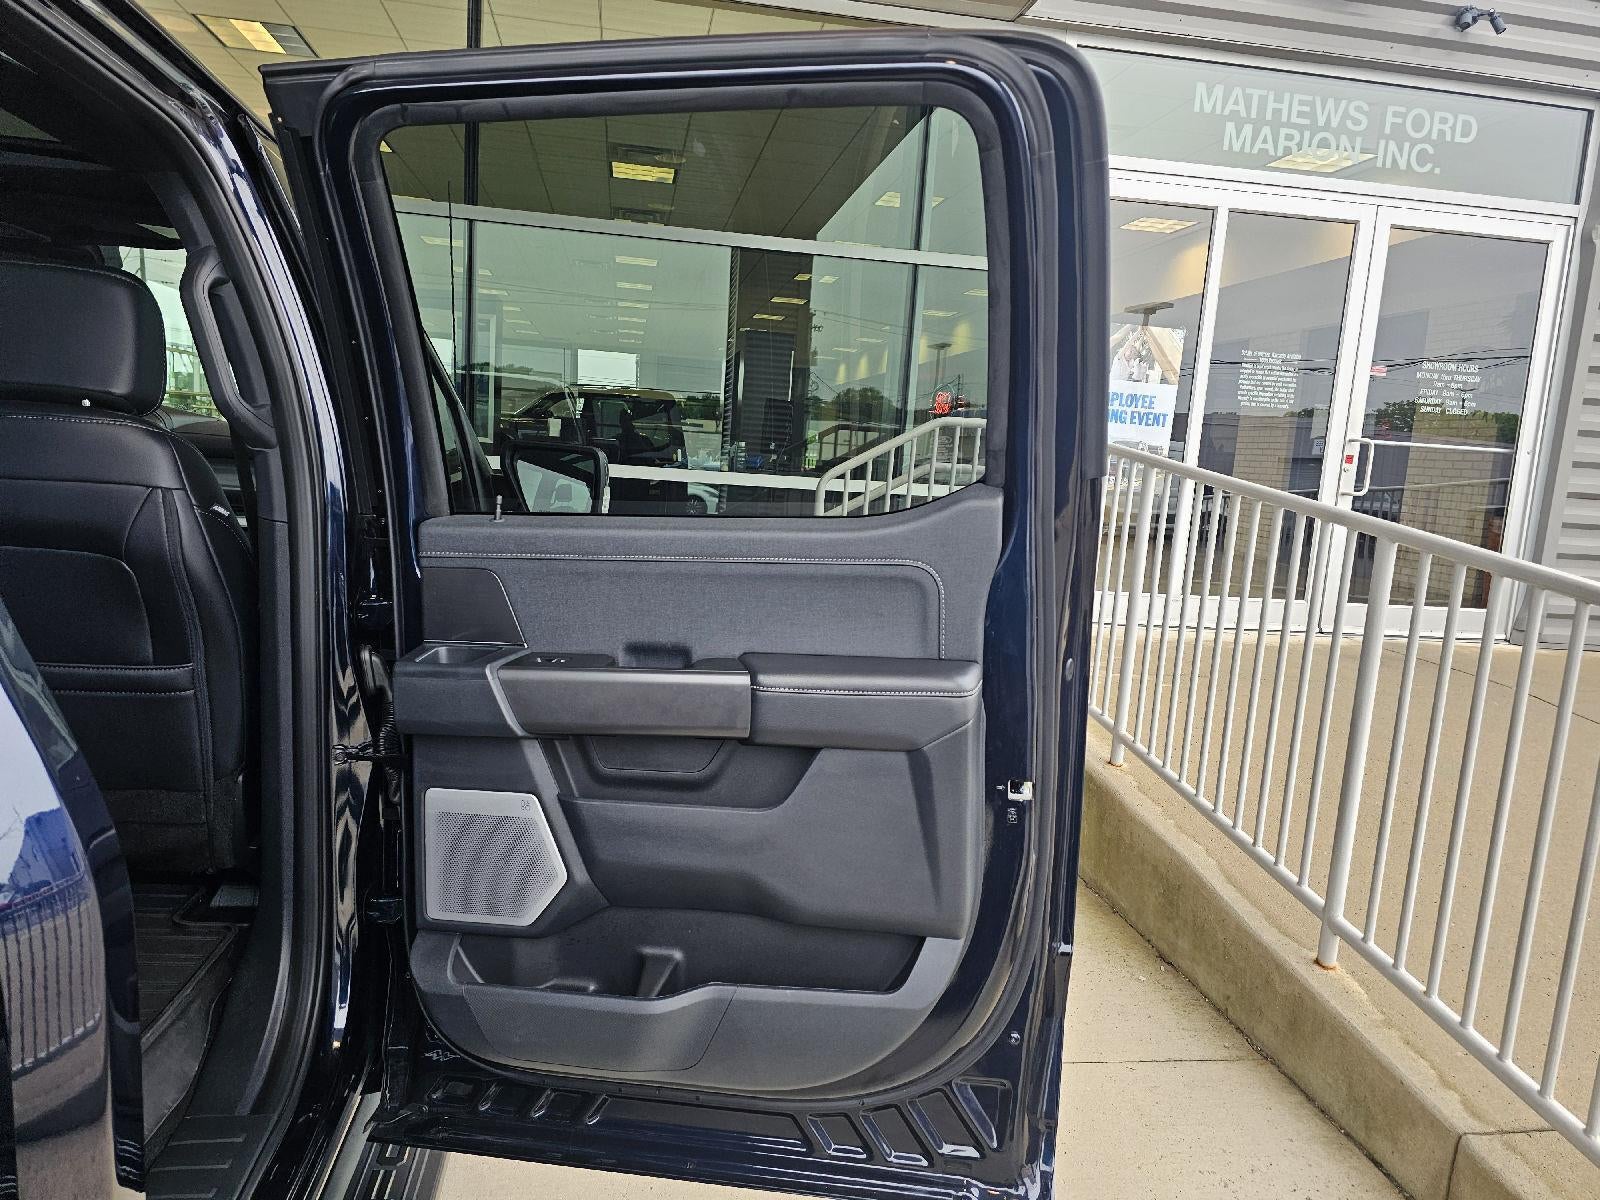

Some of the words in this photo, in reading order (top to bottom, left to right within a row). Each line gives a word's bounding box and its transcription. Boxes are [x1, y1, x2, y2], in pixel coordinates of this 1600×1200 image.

[1193, 81, 1370, 132] MATHEWS
[1384, 105, 1479, 144] FORD
[1223, 121, 1363, 165] MARION
[1376, 138, 1442, 175] INC.
[1422, 361, 1457, 371] SHOWROOM
[1458, 363, 1479, 373] HOURS
[1453, 374, 1481, 382] THURSDAY
[1107, 391, 1156, 409] PLOYEE
[1129, 410, 1168, 427] EVENT
[1420, 405, 1441, 413] SUNDAY
[1446, 407, 1468, 415] CLOSED
